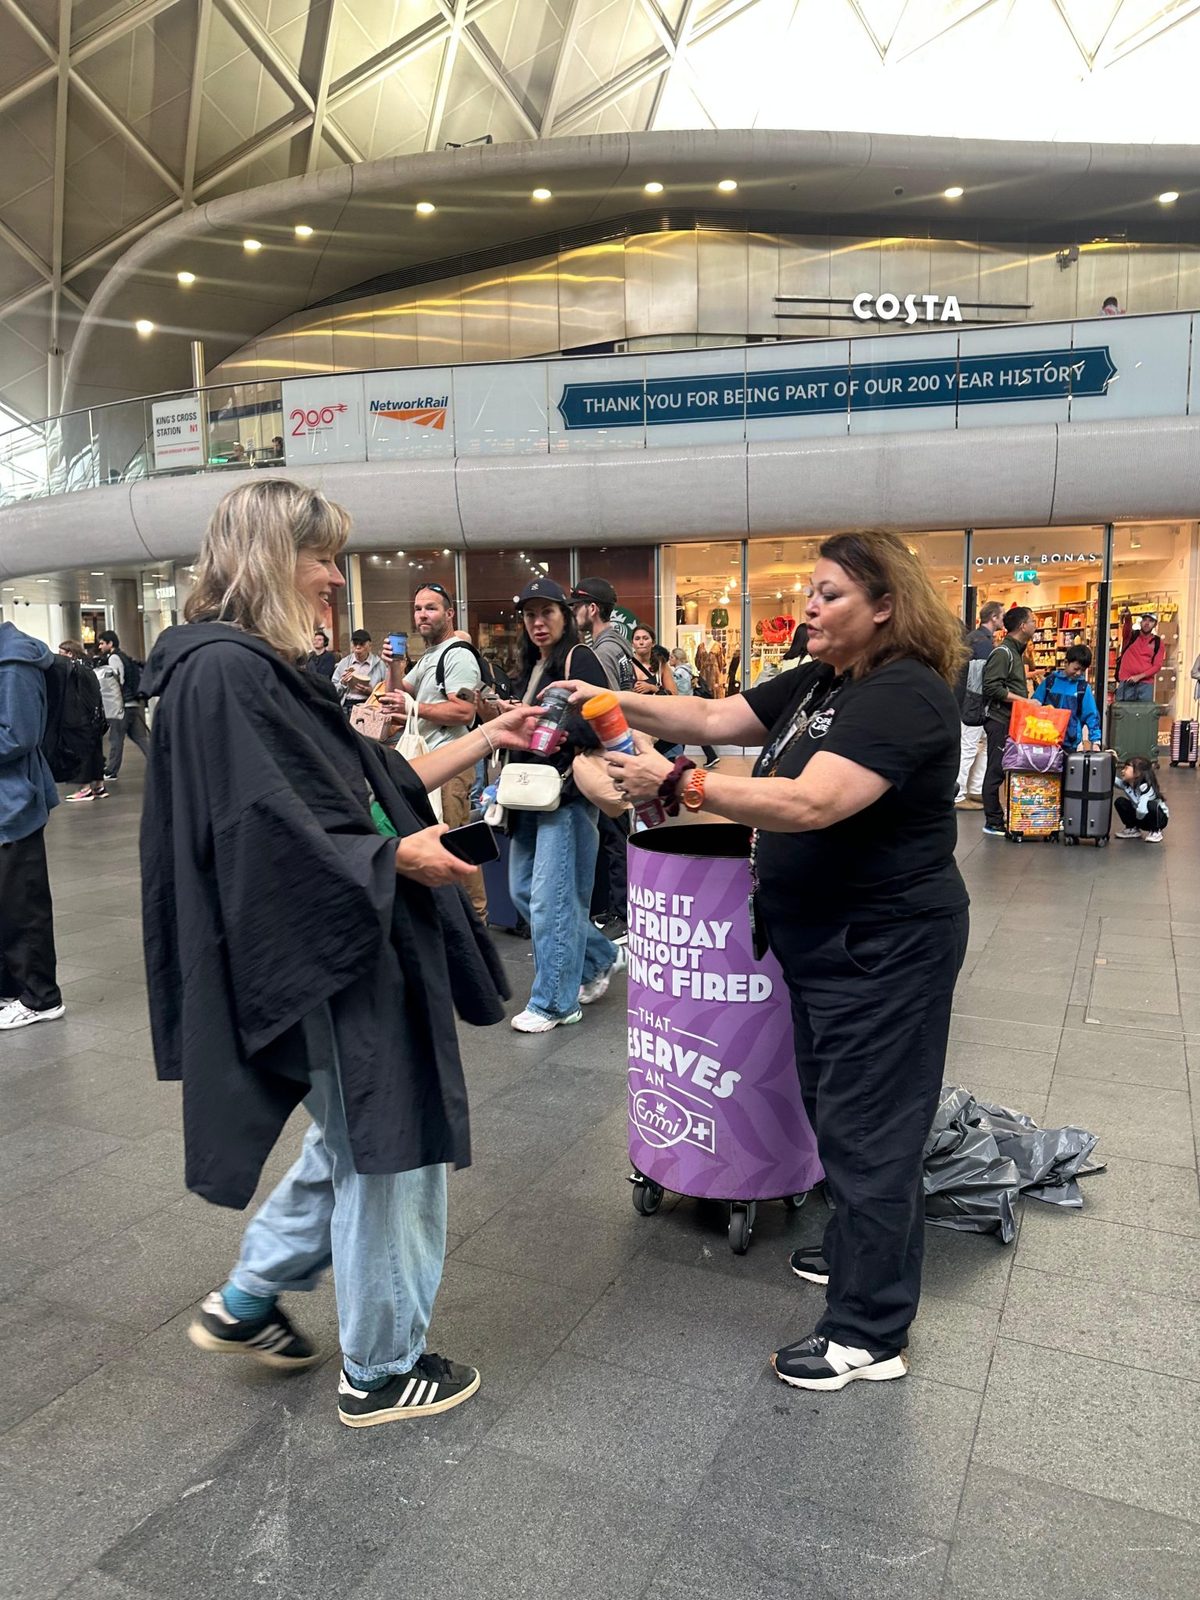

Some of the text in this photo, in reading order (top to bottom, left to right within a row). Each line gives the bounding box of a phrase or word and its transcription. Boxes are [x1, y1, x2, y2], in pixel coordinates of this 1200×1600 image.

[852, 292, 963, 325] COSTA
[583, 363, 1086, 414] THANK YOU FOR BEING PART OF OUR 200 YEAR HISTORY
[156, 411, 198, 425] KING'S CROSS
[369, 396, 449, 412] NetworkRail
[156, 424, 198, 437] STATION N1
[290, 407, 335, 436] 200
[975, 552, 1097, 566] OLIVER BONAS
[629, 881, 695, 917] MADE IT
[635, 907, 733, 949] FRIDAY
[672, 971, 773, 1003] FIRED
[638, 1007, 671, 1032] THAT
[645, 1068, 664, 1088] AN
[636, 1098, 682, 1136] Emmi
